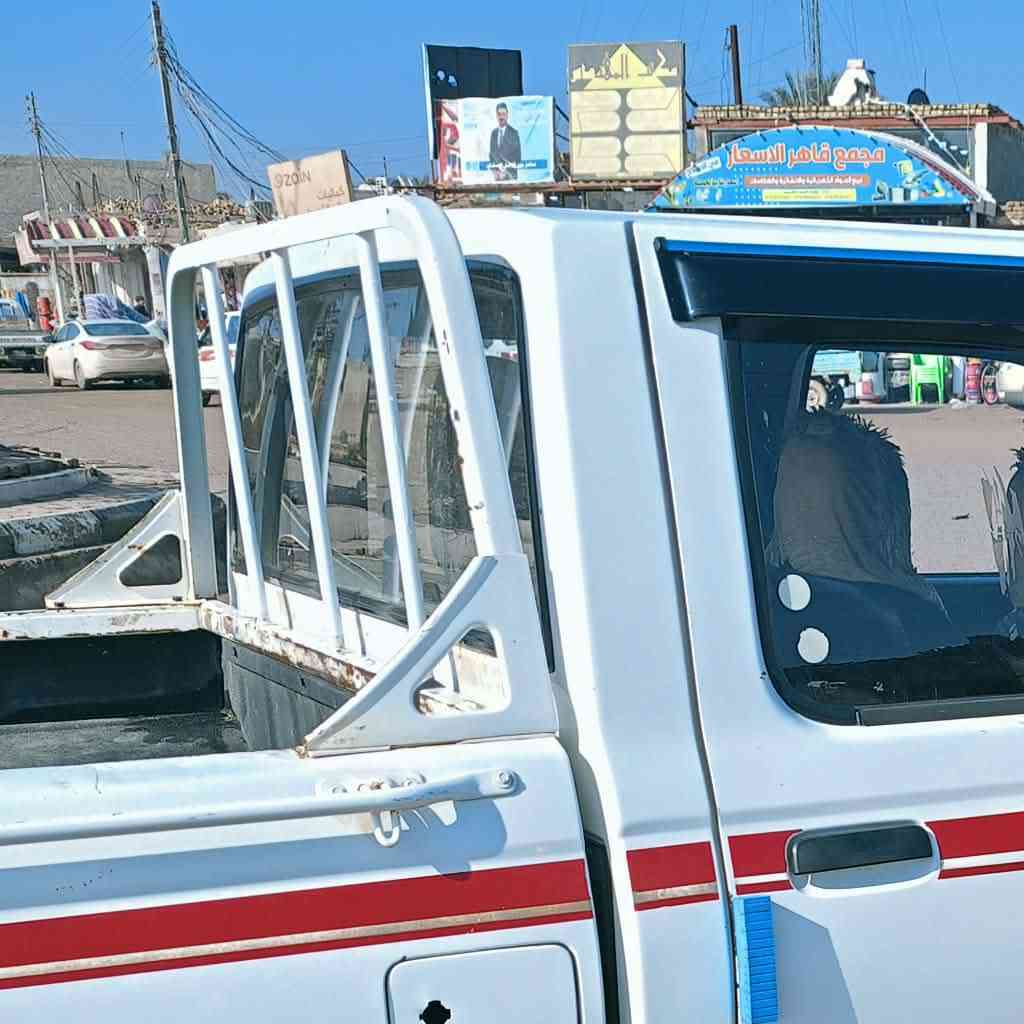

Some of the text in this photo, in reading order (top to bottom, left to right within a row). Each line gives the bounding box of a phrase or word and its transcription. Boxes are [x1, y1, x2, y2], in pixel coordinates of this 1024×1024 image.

[727, 143, 786, 169] الاسعار
[787, 143, 833, 168] قاهر
[833, 146, 887, 170] مجمع
